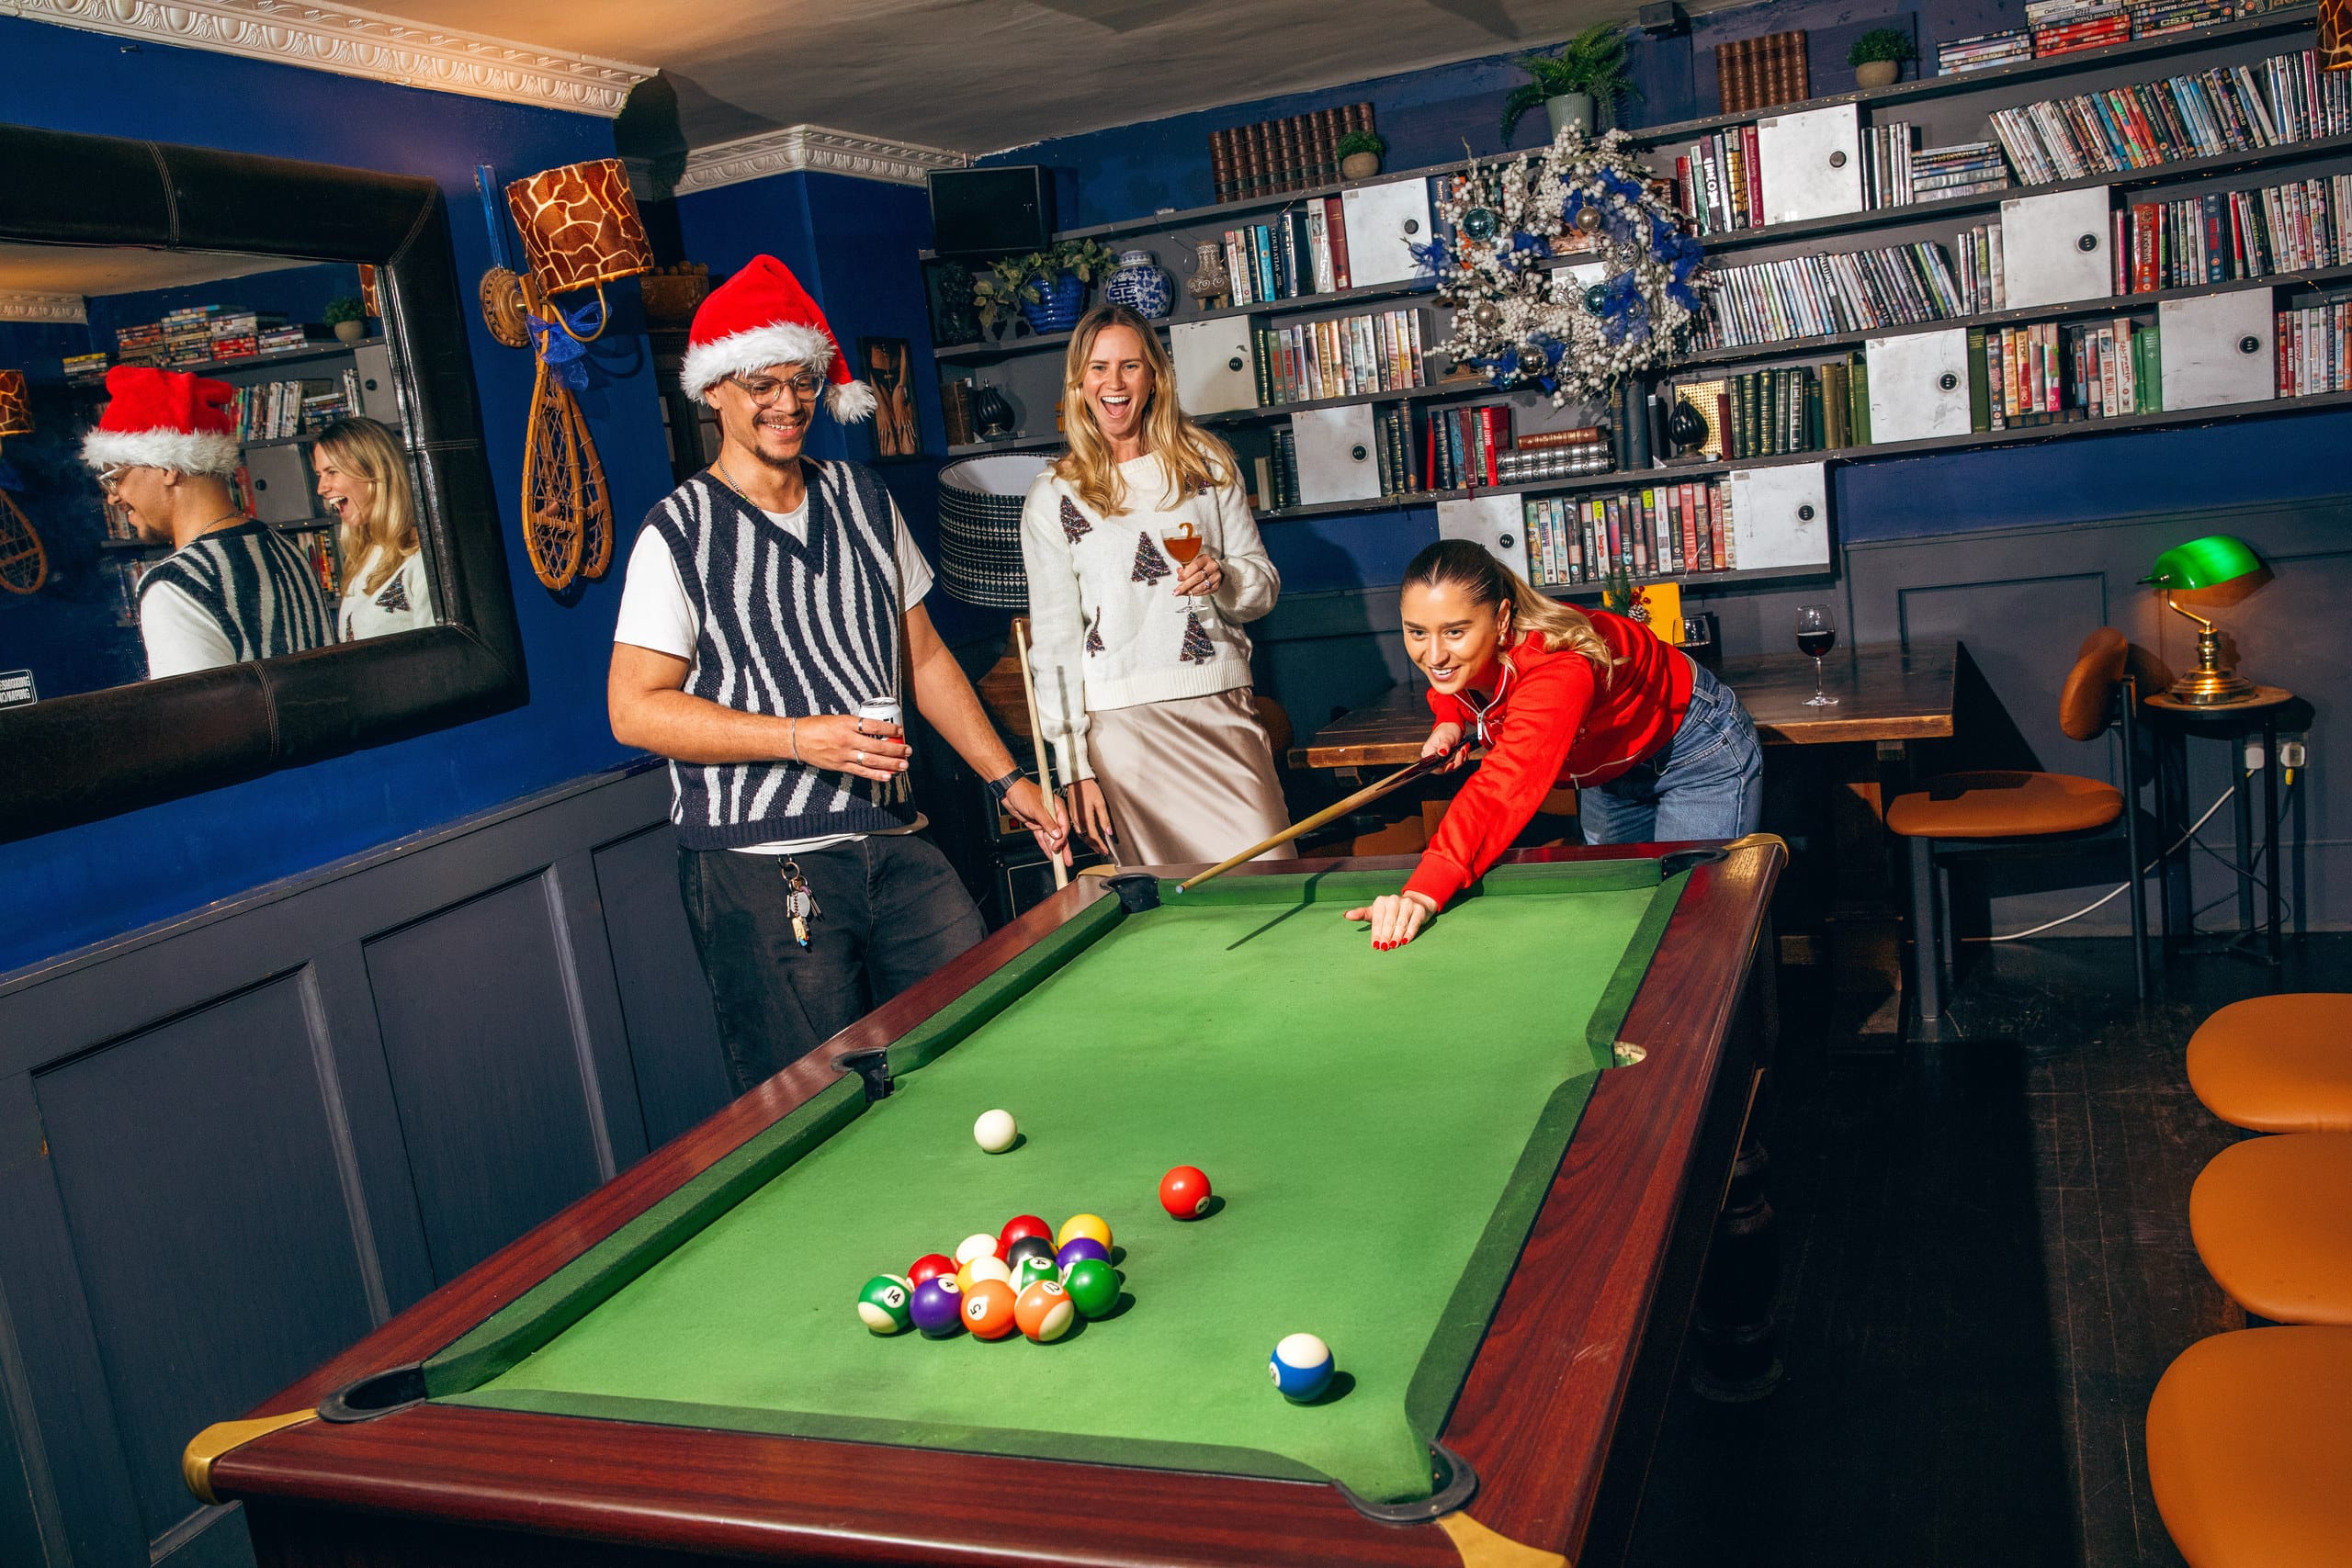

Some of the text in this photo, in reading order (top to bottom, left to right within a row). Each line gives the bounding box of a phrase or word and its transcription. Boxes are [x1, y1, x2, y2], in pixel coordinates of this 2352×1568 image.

[2156, 0, 2204, 12] AMERICAN BEAUTY
[2137, 92, 2155, 121] THE SHIELD
[2230, 93, 2247, 126] THE SHIELD
[2250, 212, 2260, 246] MONEYBALL
[1269, 227, 1281, 272] CLOUD ATLAS
[1817, 252, 1833, 285] FALLUJAH
[2286, 347, 2295, 371] BLOW
[2293, 334, 2303, 361] blow
[1584, 527, 1593, 556] ARLINGTON
[6, 688, 30, 702] VAPING
[888, 1290, 901, 1303] 14
[969, 1303, 981, 1315] 5
